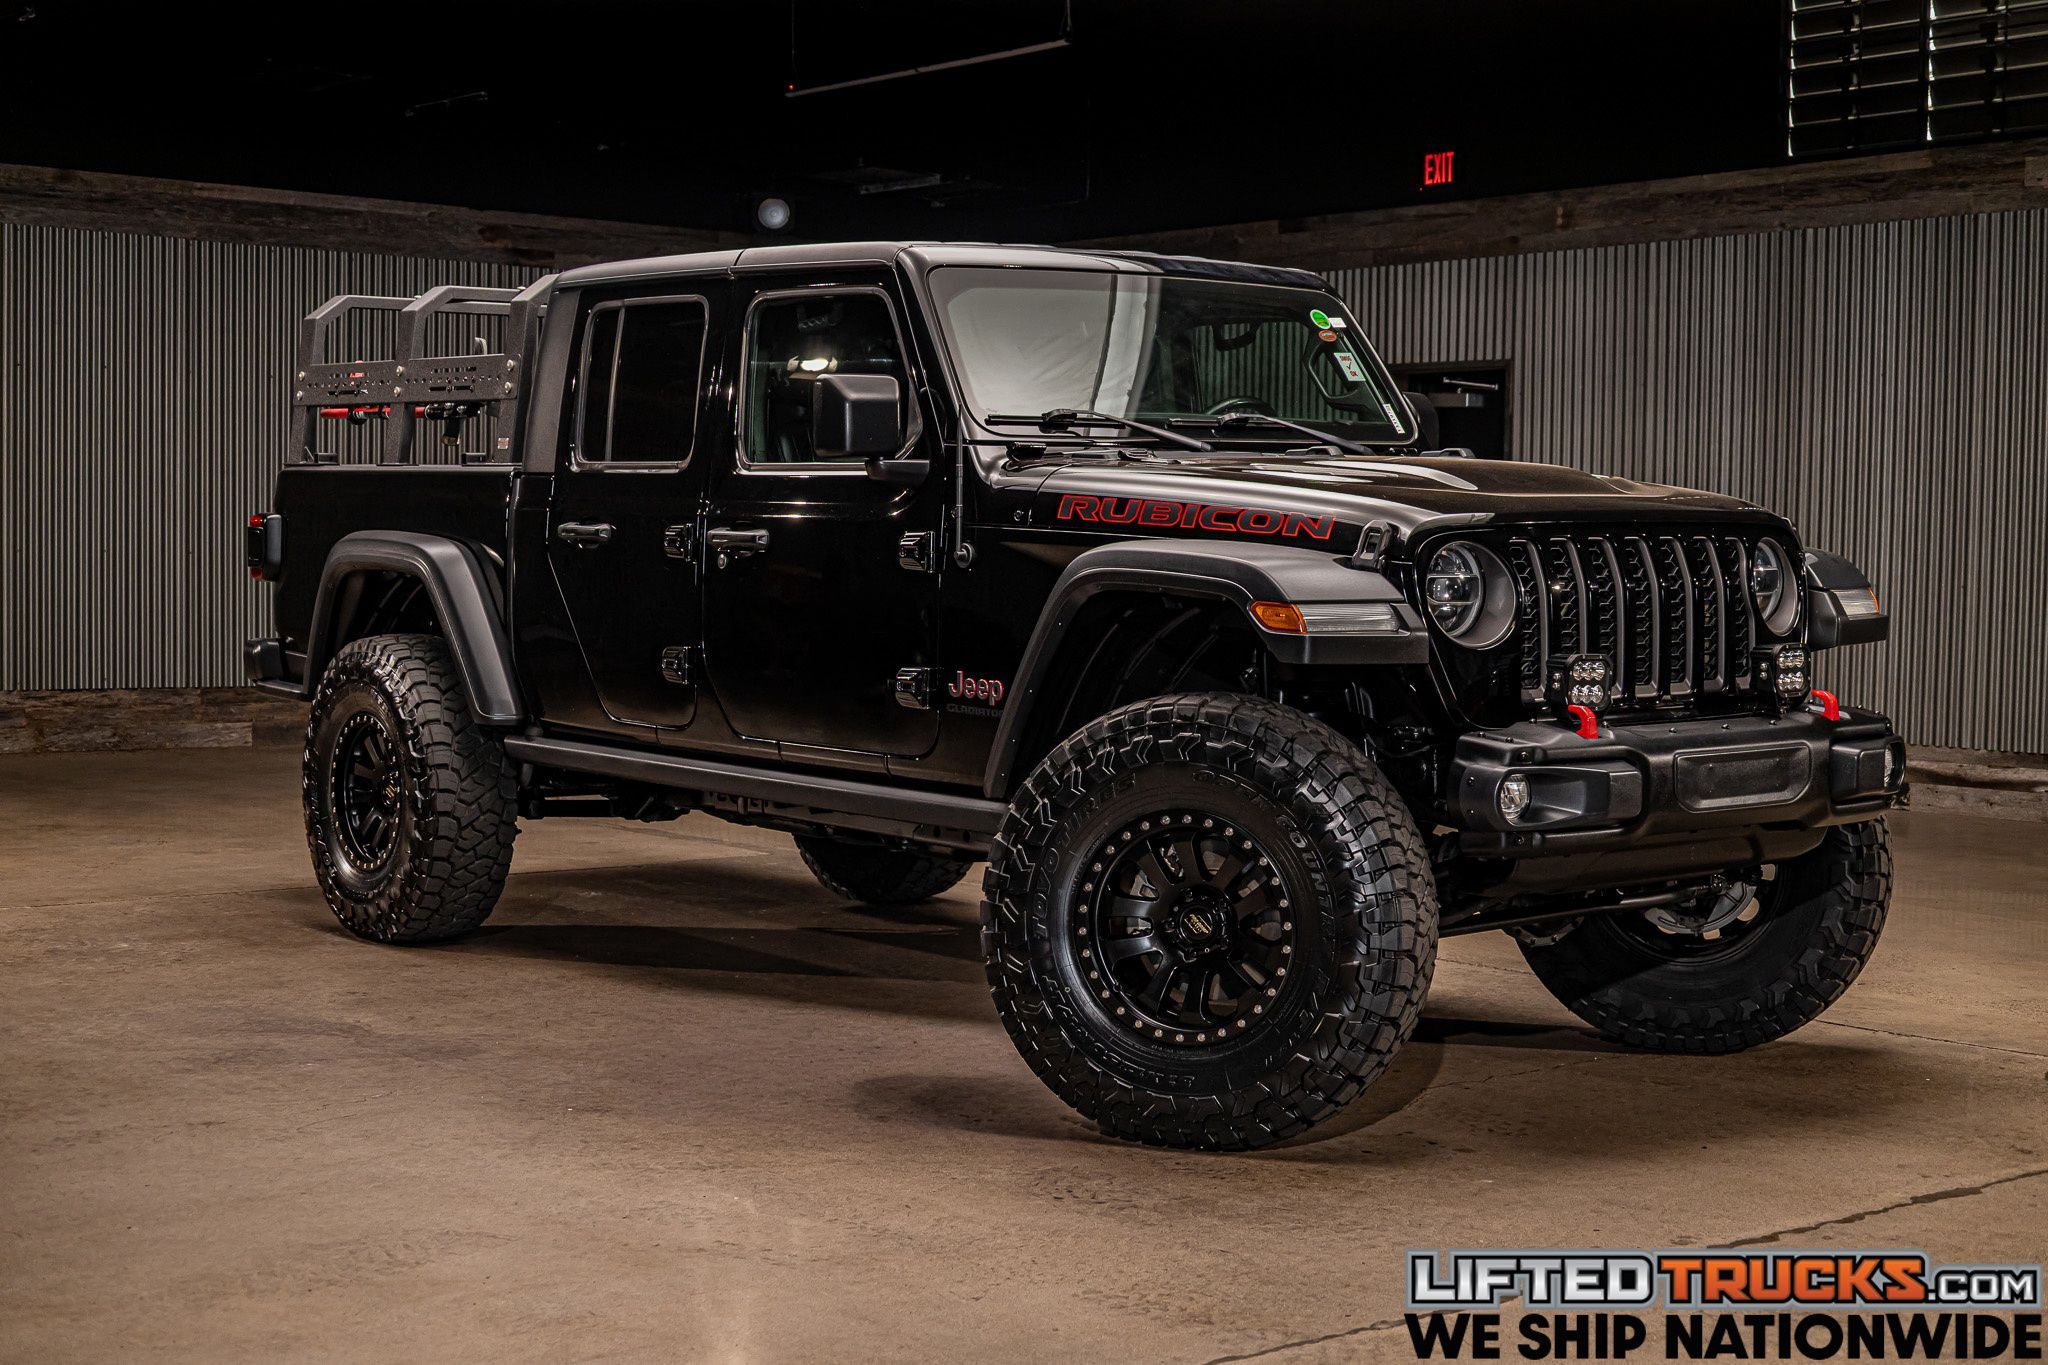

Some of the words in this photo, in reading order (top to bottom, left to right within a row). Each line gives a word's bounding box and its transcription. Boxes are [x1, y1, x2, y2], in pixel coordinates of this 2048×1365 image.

[1425, 151, 1455, 185] EXIT
[1057, 494, 1337, 539] RUBICON
[948, 670, 1004, 706] Jeep
